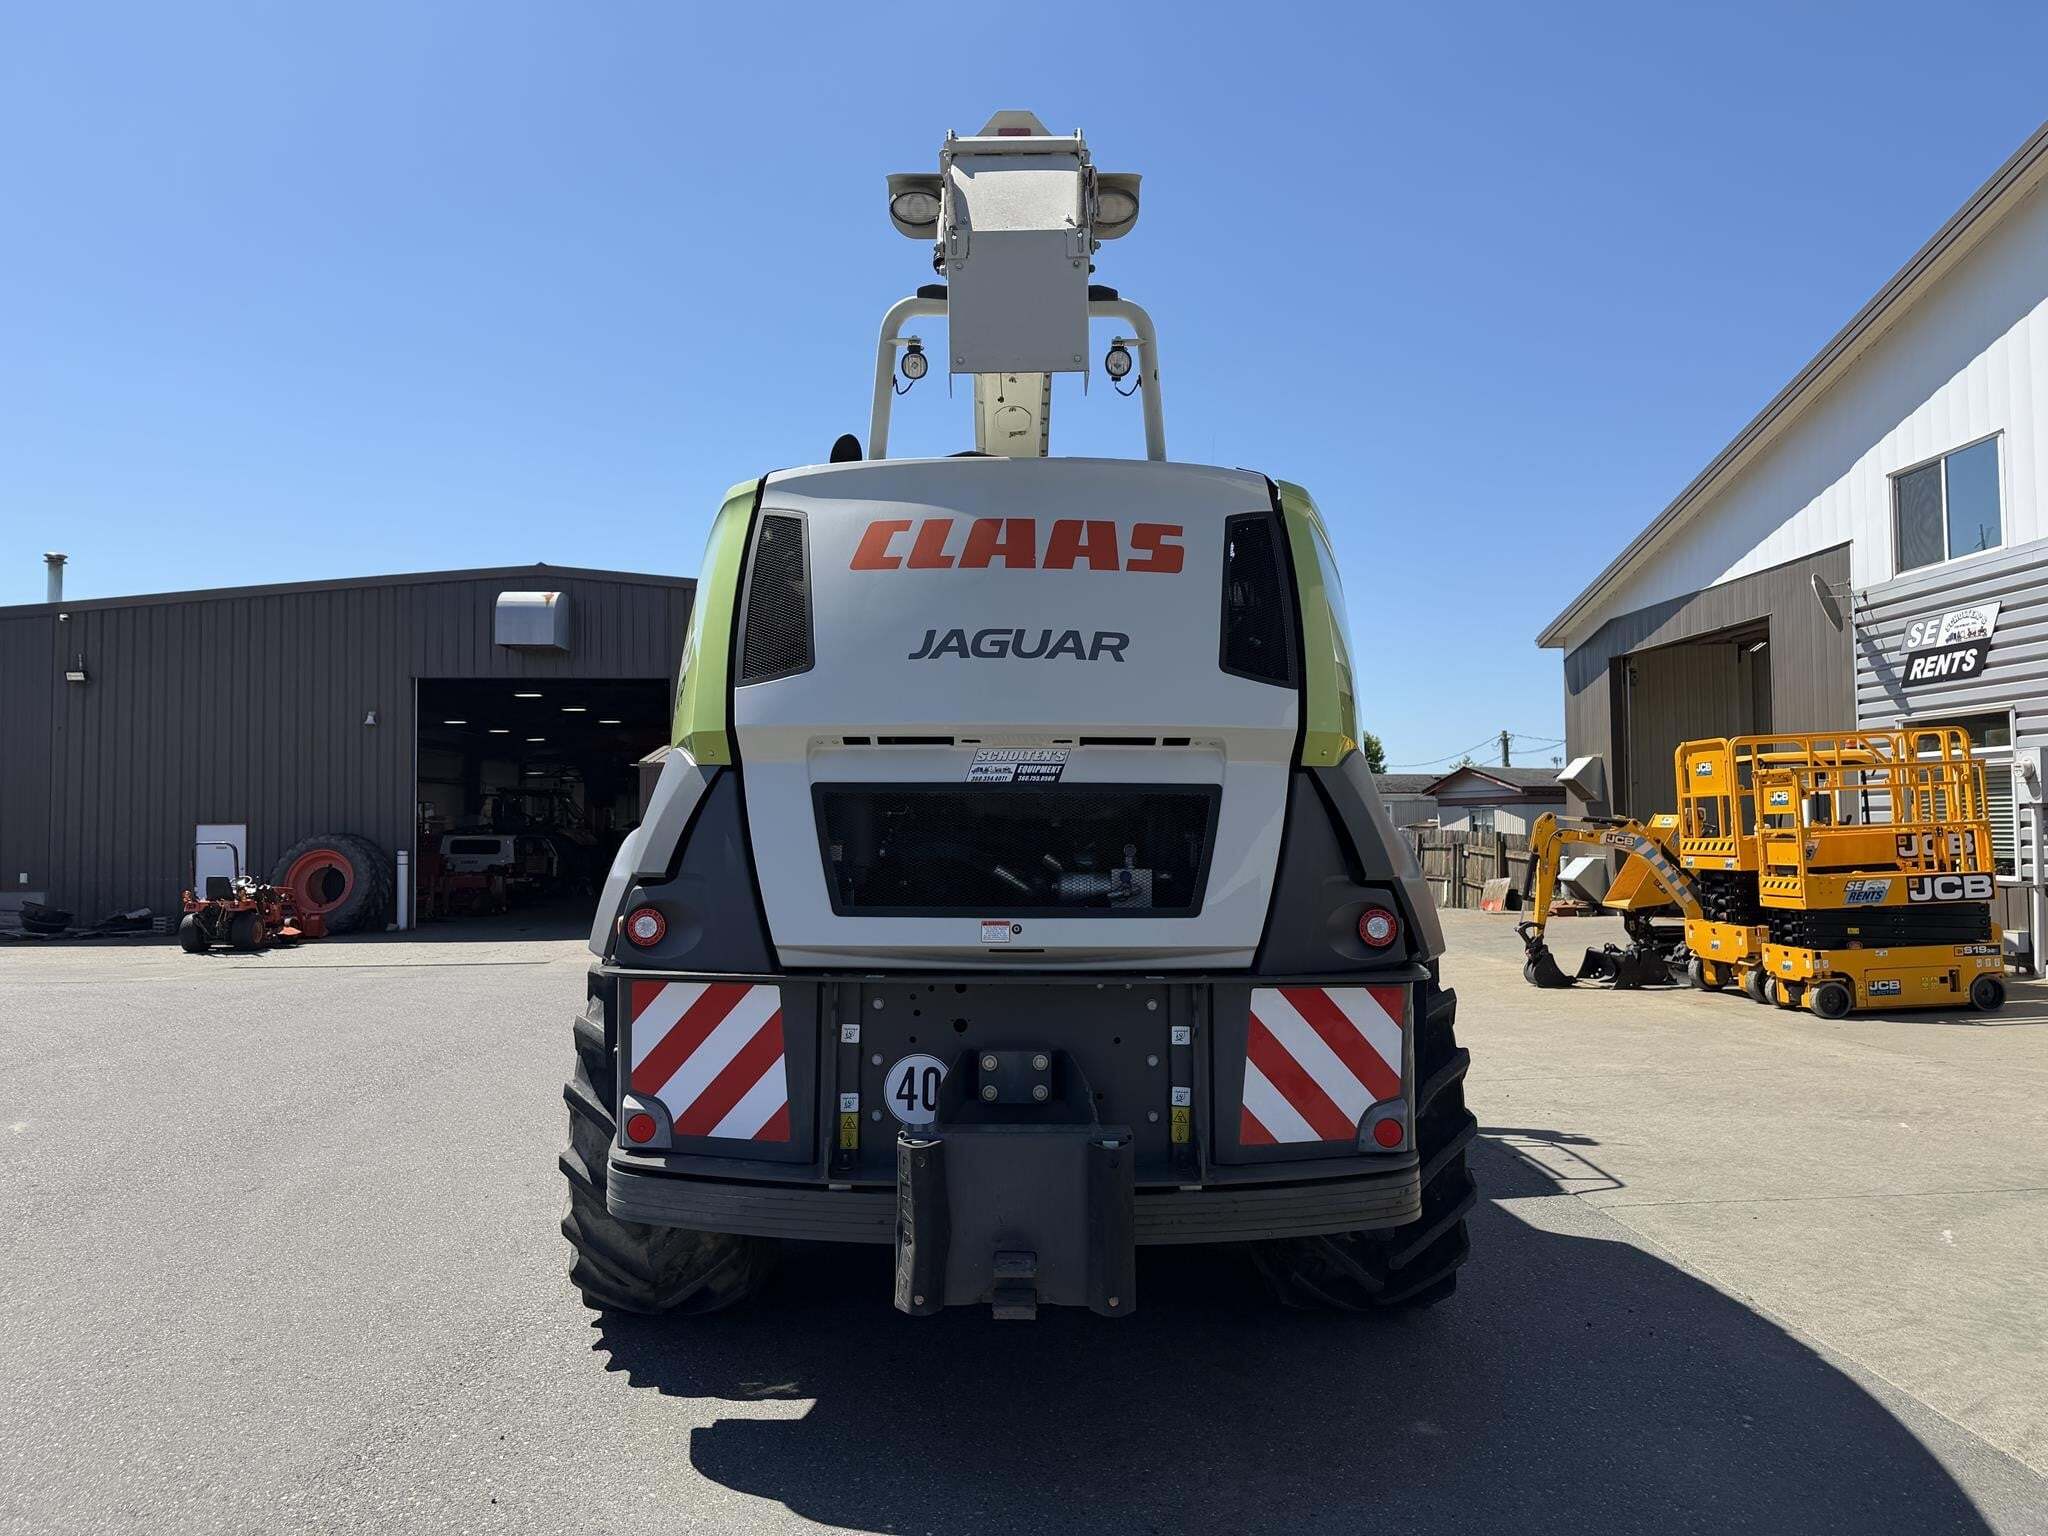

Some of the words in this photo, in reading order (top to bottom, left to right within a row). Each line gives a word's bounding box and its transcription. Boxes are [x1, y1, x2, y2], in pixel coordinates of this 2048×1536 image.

[849, 518, 1184, 574] CLAAS
[1907, 618, 1940, 648] SE
[907, 628, 1130, 663] JAGUAR
[1909, 648, 1978, 681] RENTS
[976, 749, 1067, 762] SCHOLTEN'S
[1017, 765, 1063, 774] EQUIPMENT
[1696, 762, 1712, 772] JCB
[1770, 791, 1789, 801] JCB
[1607, 833, 1635, 847] JCB
[1844, 881, 1862, 892] SE
[1909, 874, 1993, 901] JCB
[1849, 890, 1883, 901] RENTS
[1869, 980, 1901, 991] JCB
[896, 1066, 942, 1111] 40
